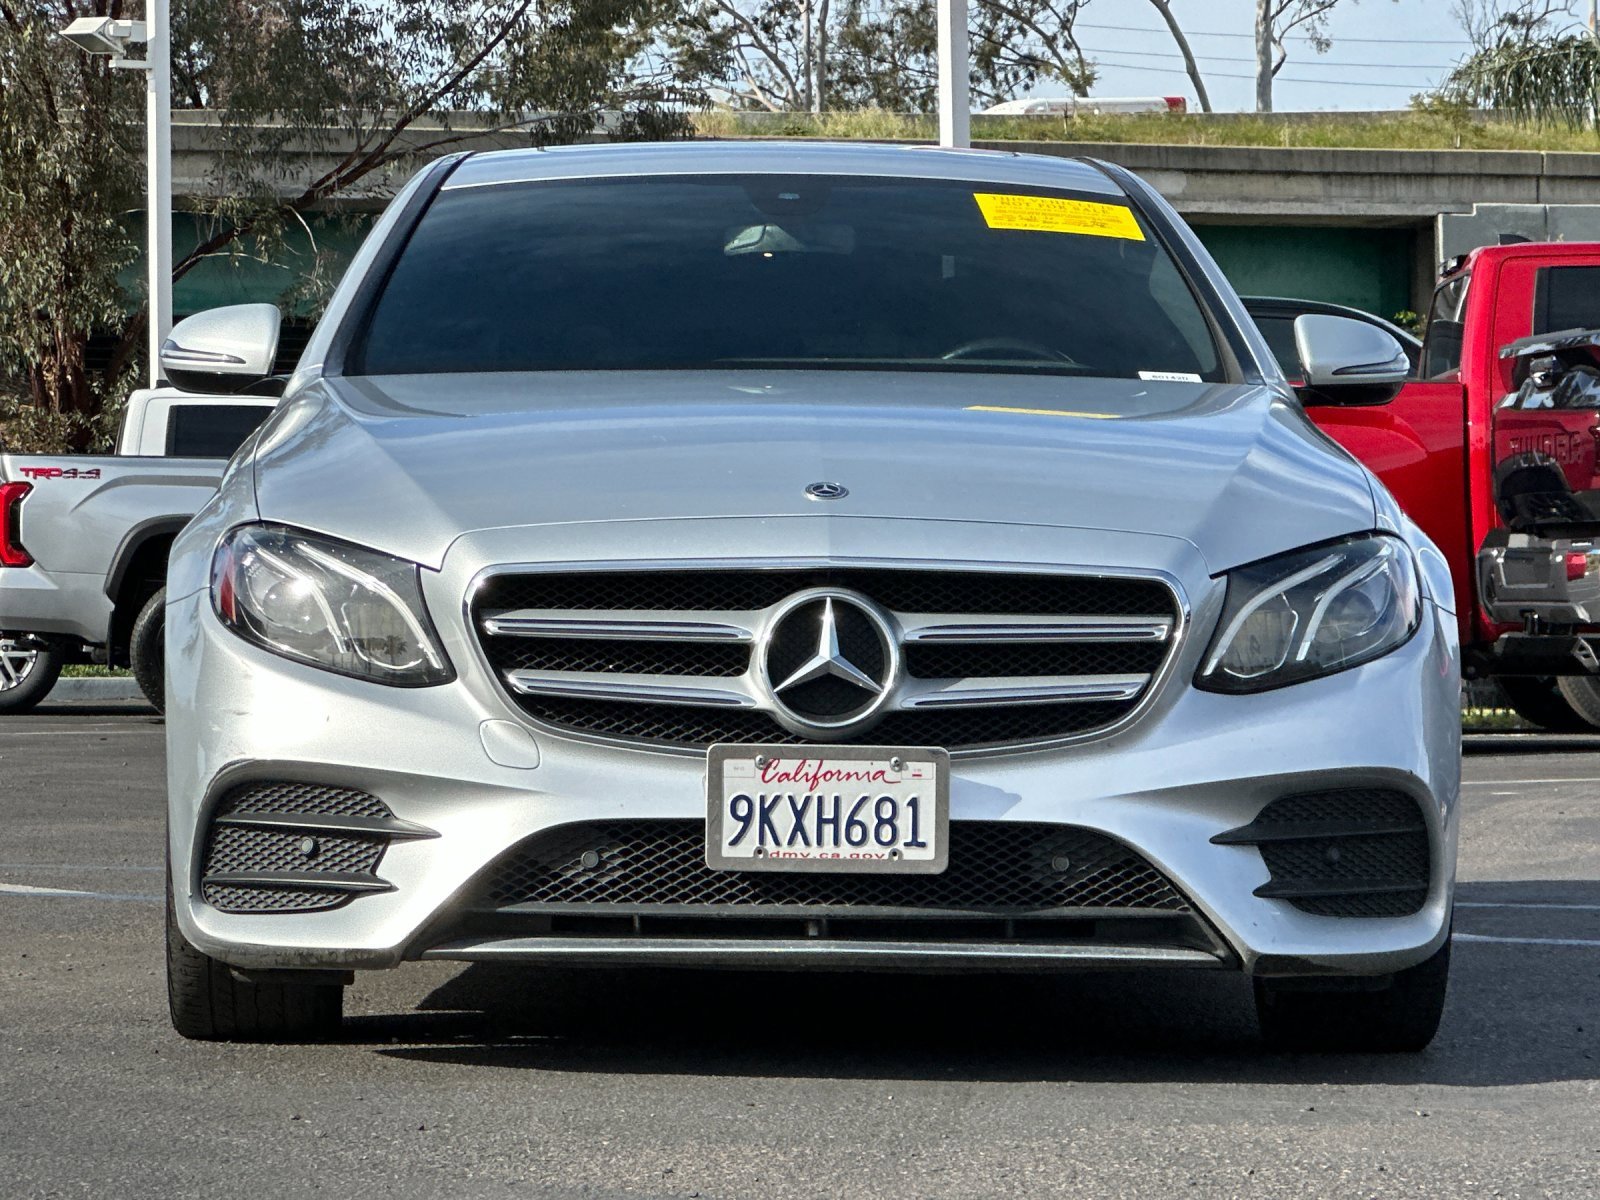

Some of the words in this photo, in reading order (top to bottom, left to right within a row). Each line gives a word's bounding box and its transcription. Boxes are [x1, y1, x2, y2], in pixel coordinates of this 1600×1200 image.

[20, 467, 63, 480] TRD
[761, 758, 901, 792] California
[728, 794, 927, 848] 9KXH681
[769, 850, 886, 860] dmv.ca.gov
